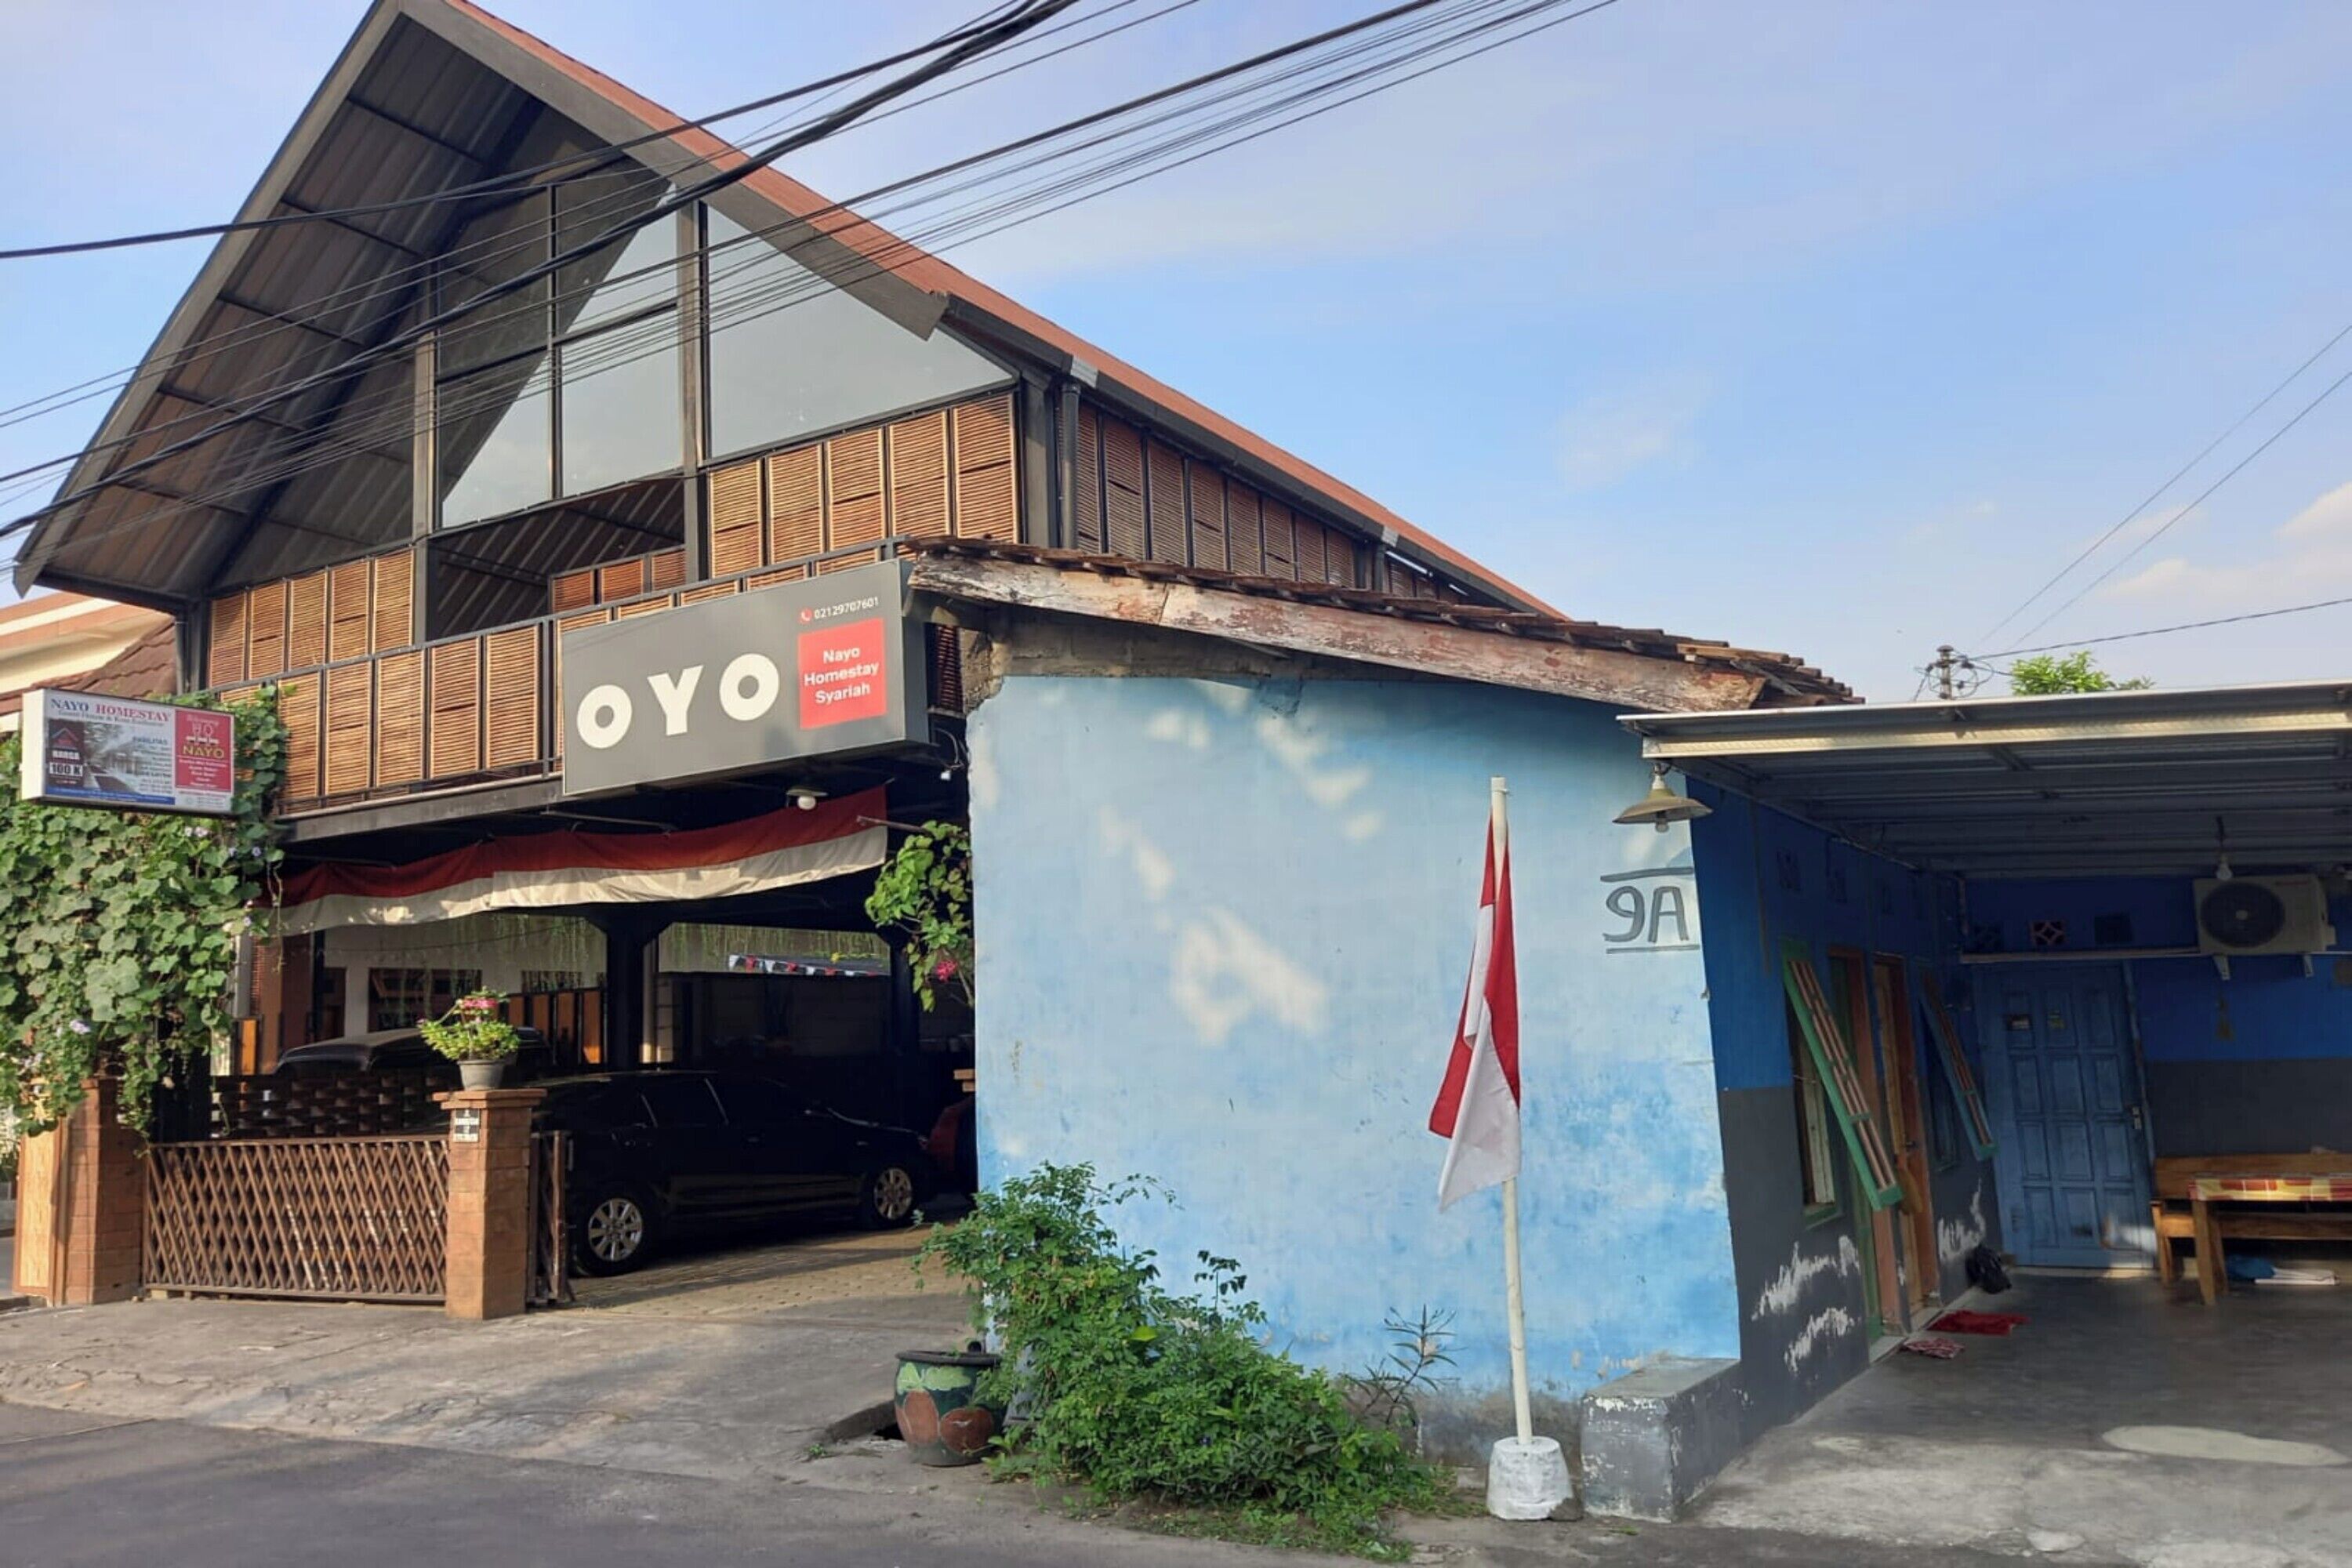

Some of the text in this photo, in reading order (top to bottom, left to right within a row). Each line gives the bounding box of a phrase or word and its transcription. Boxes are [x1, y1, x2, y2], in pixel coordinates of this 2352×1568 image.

[814, 597, 879, 619] 02129707601
[823, 647, 860, 663] Nayo
[804, 662, 880, 687] Homestay
[576, 652, 779, 749] OYO
[815, 682, 871, 705] Syariah
[50, 698, 89, 712] NAYO
[96, 703, 170, 722] HOMESTAY
[183, 745, 224, 759] NAYO
[1602, 885, 1690, 943] 9A
